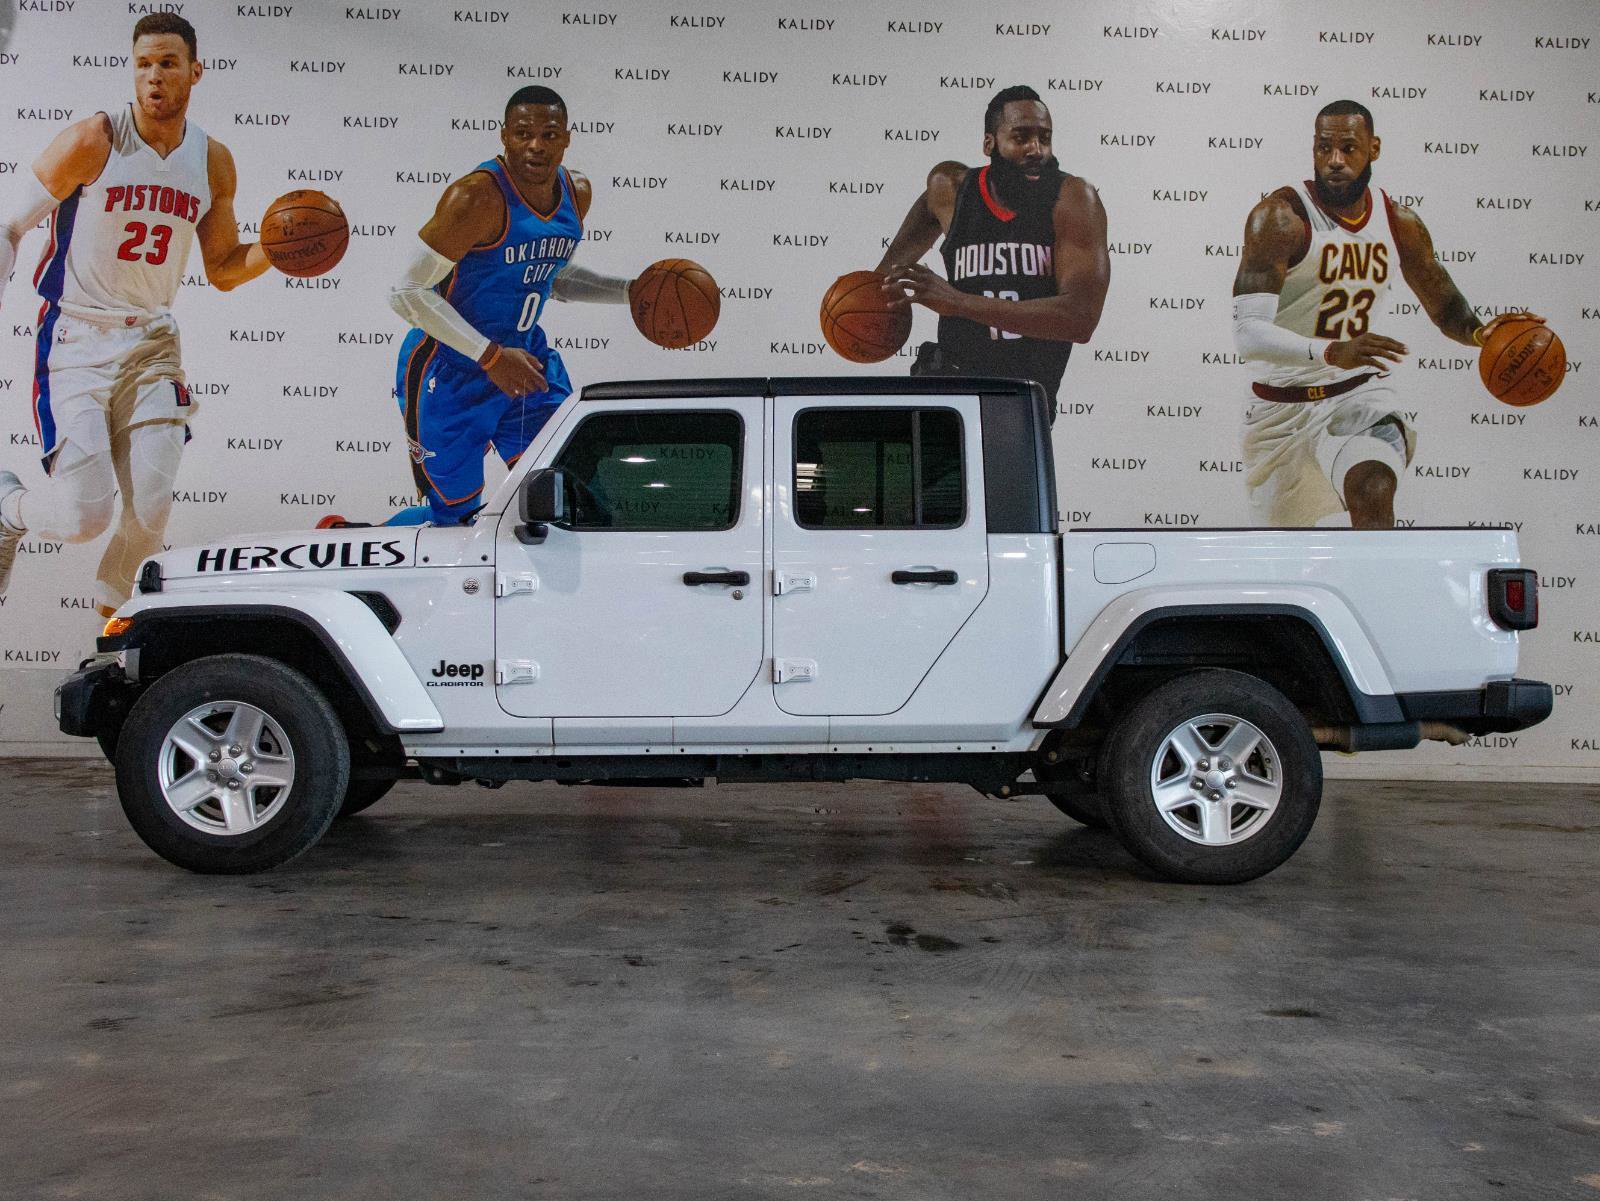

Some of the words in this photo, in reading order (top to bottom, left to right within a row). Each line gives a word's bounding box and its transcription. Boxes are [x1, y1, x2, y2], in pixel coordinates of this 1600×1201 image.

[19, 0, 75, 11] KALIDY
[128, 2, 184, 14] KALIDY
[238, 6, 293, 17] KALIDY
[346, 8, 401, 20] KALIDY
[454, 11, 509, 22] KALIDY
[563, 13, 618, 25] KALIDY
[671, 16, 726, 28] KALIDY
[779, 19, 834, 30] KALIDY
[887, 21, 942, 33] KALIDY
[995, 24, 1050, 35] KALIDY
[1103, 27, 1158, 38] KALIDY
[1211, 29, 1266, 41] KALIDY
[1319, 32, 1374, 43] KALIDY
[1427, 35, 1482, 46] KALIDY
[1535, 37, 1590, 49] KALIDY
[74, 56, 129, 68] KALIDY
[203, 58, 237, 70] LIDY
[290, 61, 345, 73] KALIDY
[399, 64, 454, 75] KALIDY
[507, 66, 562, 78] KALIDY
[615, 69, 670, 80] KALIDY
[724, 71, 779, 83] KALIDY
[832, 74, 887, 86] KALIDY
[940, 77, 995, 88] KALIDY
[1048, 79, 1103, 91] KALIDY
[1156, 82, 1211, 93] KALIDY
[1264, 85, 1319, 96] KALIDY
[1372, 87, 1427, 99] KALIDY
[1480, 90, 1535, 101] KALIDY
[18, 109, 73, 121] KALIDY
[235, 114, 290, 126] KALIDY
[343, 117, 398, 128] KALIDY
[570, 122, 614, 133] ALIDY
[668, 124, 723, 136] KALIDY
[776, 127, 831, 138] KALIDY
[884, 129, 939, 141] KALIDY
[1100, 135, 1155, 146] KALIDY
[1208, 137, 1263, 149] KALIDY
[1424, 143, 1479, 154] KALIDY
[1532, 145, 1587, 157] KALIDY
[288, 169, 343, 181] KALIDY
[396, 172, 451, 183] KALIDY
[613, 177, 668, 188] KALIDY
[721, 180, 776, 191] KALIDY
[829, 182, 884, 194] KALIDY
[1153, 190, 1208, 201] KALIDY
[1398, 195, 1424, 206] IDY
[105, 185, 200, 223] PISTONS
[1477, 198, 1532, 209] KALIDY
[351, 225, 396, 236] ALIDY
[584, 230, 612, 241] IDY
[117, 221, 173, 265] 23
[665, 232, 720, 244] KALIDY
[773, 235, 828, 246] KALIDY
[505, 238, 576, 264] OKLAHOM
[1108, 243, 1152, 254] ALIDY
[1205, 245, 1239, 256] KALI
[955, 242, 1052, 280] HOUSTON
[1433, 251, 1476, 262] ALIDY
[1529, 253, 1584, 265] KALIDY
[1319, 243, 1388, 284] CAVS
[523, 263, 556, 284] CITY
[285, 278, 340, 289] KALIDY
[1150, 298, 1205, 309] KALIDY
[1388, 303, 1420, 315] IDY
[517, 292, 541, 332] 0
[1314, 288, 1376, 340] 23
[230, 330, 285, 342] KALIDY
[338, 333, 393, 344] KALIDY
[555, 338, 610, 349] KALIDY
[771, 343, 826, 354] KALIDY
[1095, 350, 1150, 362] KALIDY
[1418, 358, 1473, 370] KALIDY
[186, 383, 229, 394] ALIDY
[283, 386, 338, 397] KALIDY
[1307, 387, 1326, 399] CLE
[1059, 403, 1093, 414] LIDY
[1147, 406, 1202, 417] KALIDY
[1471, 414, 1526, 425] KALIDY
[10, 433, 38, 444] KAL
[227, 439, 282, 450] KALIDY
[336, 441, 391, 452] KALIDY
[1092, 458, 1147, 470] KALIDY
[1199, 460, 1242, 472] KALID
[1416, 466, 1471, 478] KALIDY
[1523, 469, 1578, 480] KALIDY
[172, 491, 227, 503] KALIDY
[280, 494, 335, 505] KALIDY
[615, 501, 659, 512] ALIDY
[1057, 511, 1091, 522] LIDY
[1145, 514, 1200, 525] KALIDY
[17, 542, 63, 553] ALIDY
[197, 540, 405, 571] HERCULES
[1541, 576, 1576, 588] LIDY
[60, 597, 94, 608] KALI
[1573, 631, 1600, 642] KAL
[6, 650, 61, 662] KALIDY
[432, 660, 484, 680] Jeep
[1571, 738, 1599, 750] KAL
